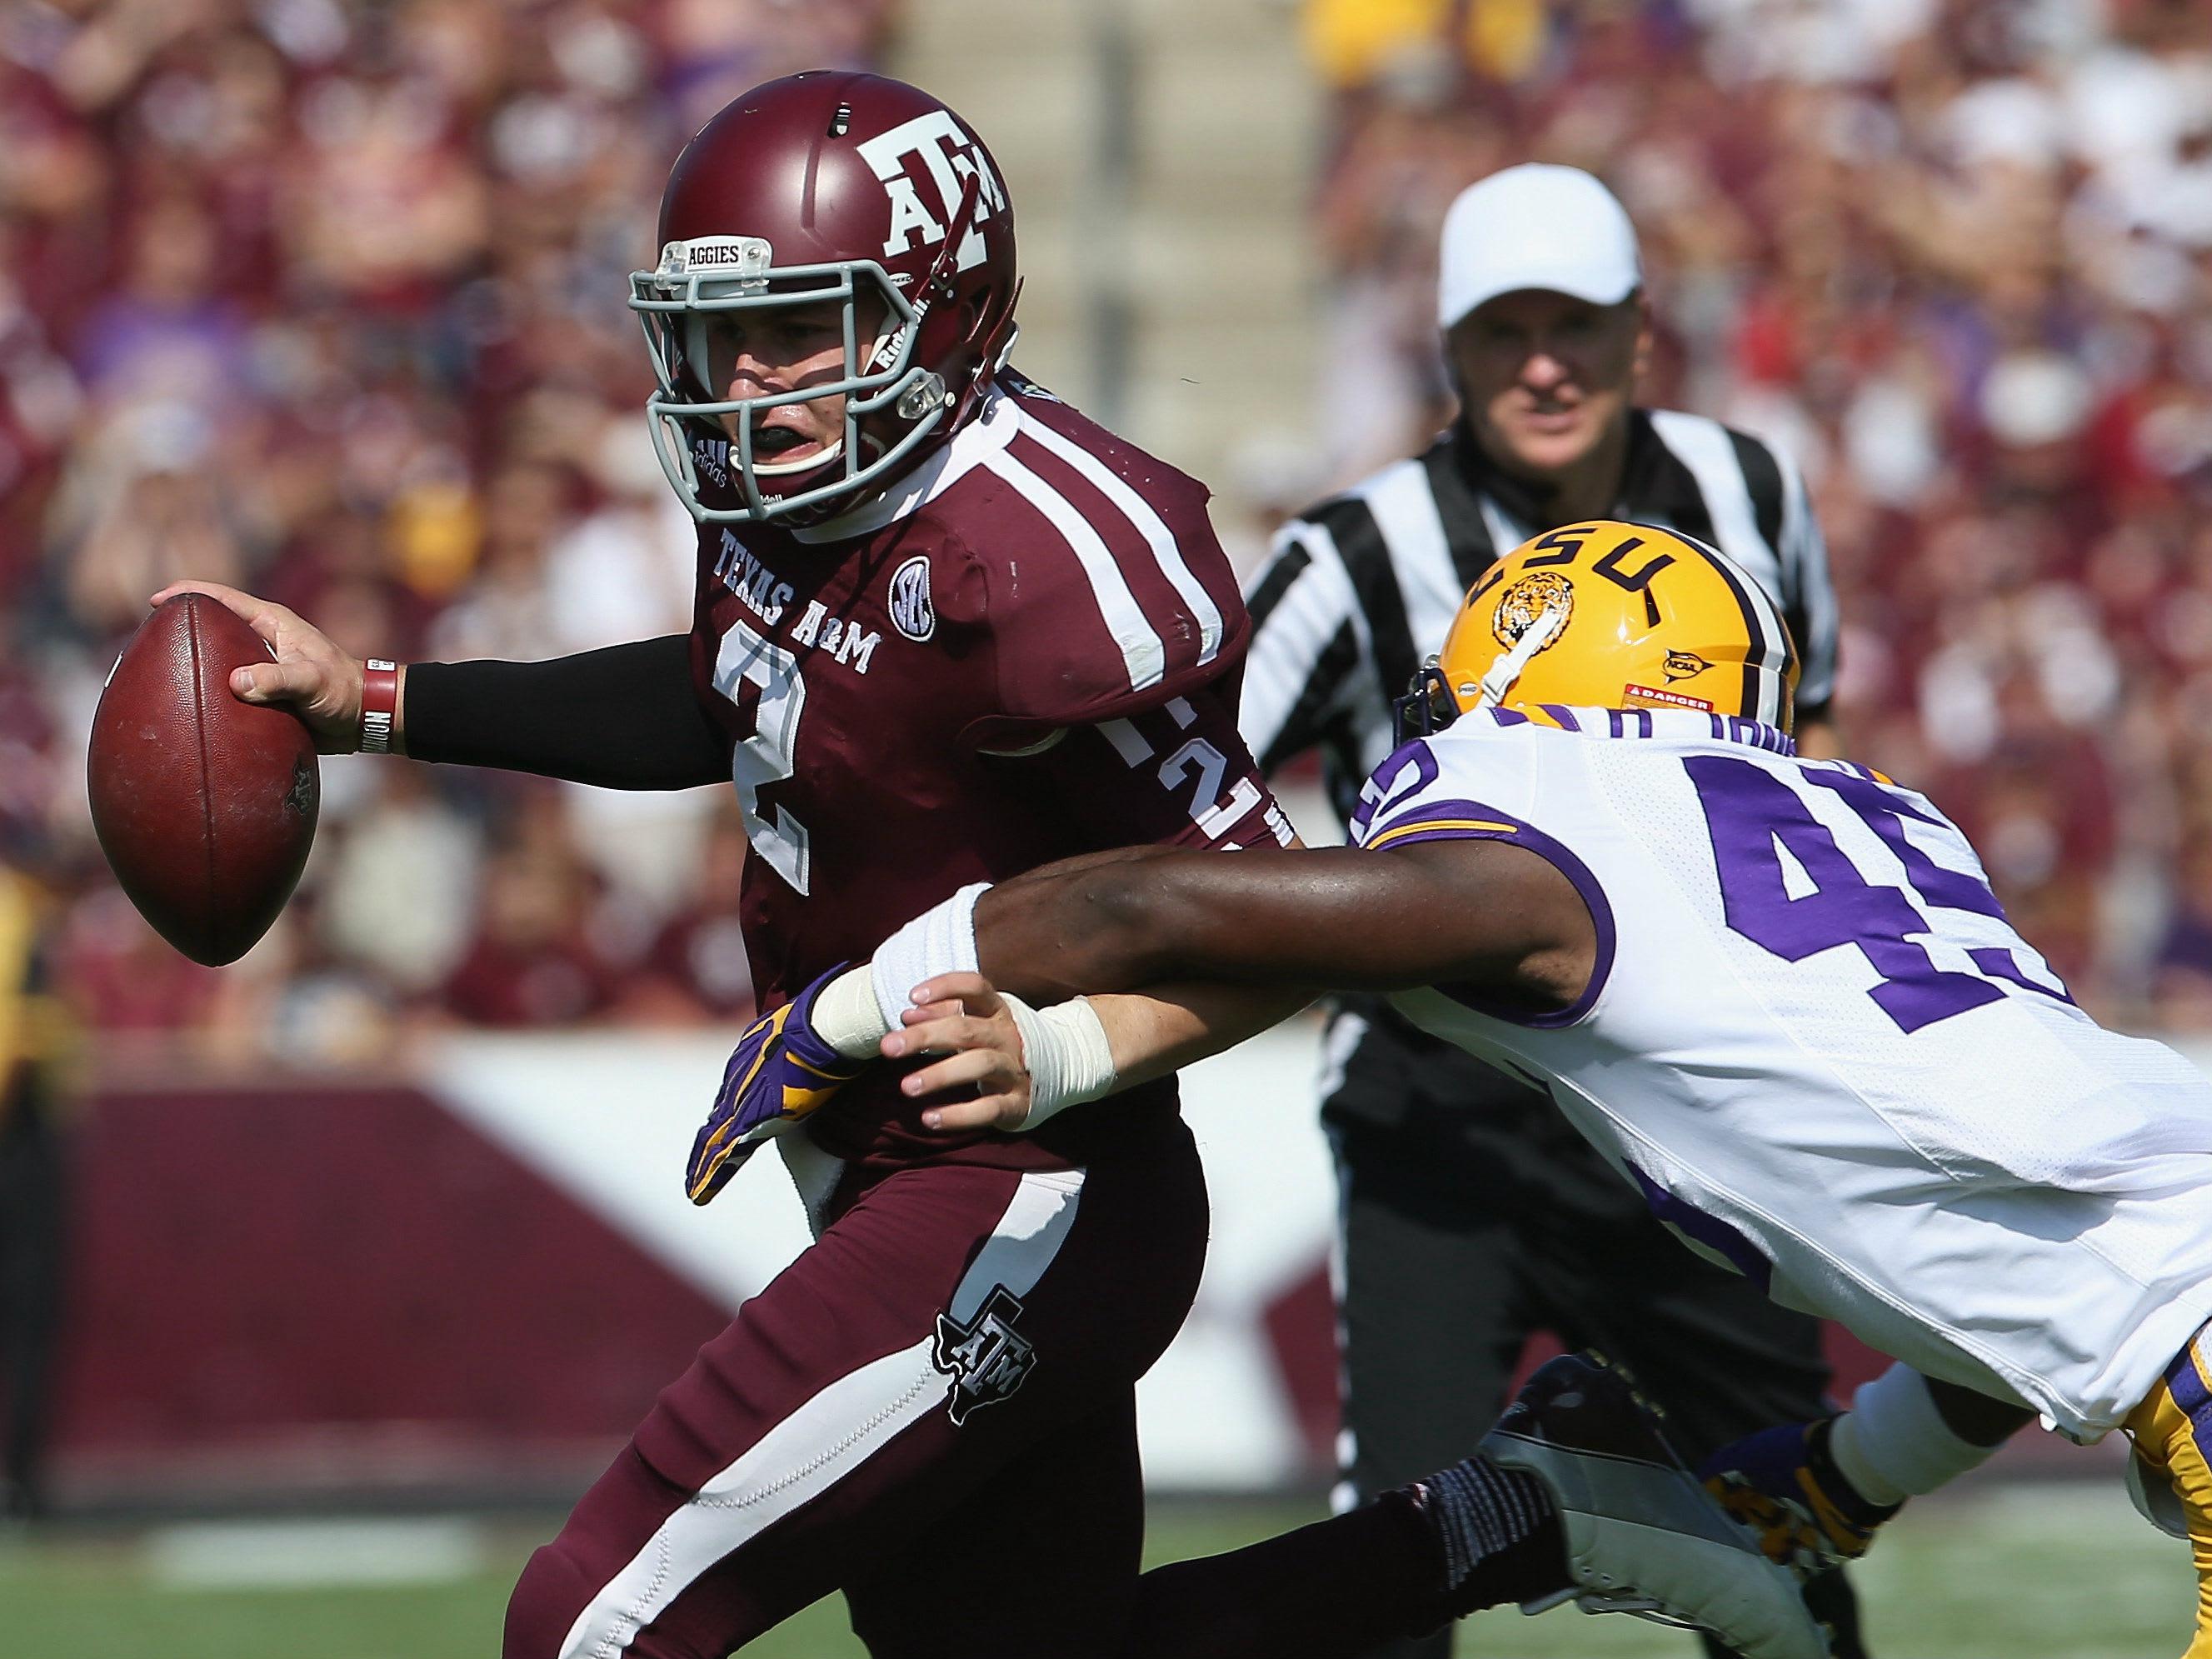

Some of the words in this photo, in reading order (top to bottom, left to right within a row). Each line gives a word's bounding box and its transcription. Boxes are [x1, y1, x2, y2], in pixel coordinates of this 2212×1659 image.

[689, 245, 739, 266] AGGIES
[713, 527, 795, 626] TEXAS
[791, 599, 882, 675] A&M
[894, 563, 931, 636] SEC
[1641, 689, 1709, 710] DANGER
[712, 618, 810, 897] 2
[1156, 737, 1263, 841] 2
[1680, 755, 2080, 1034] 45
